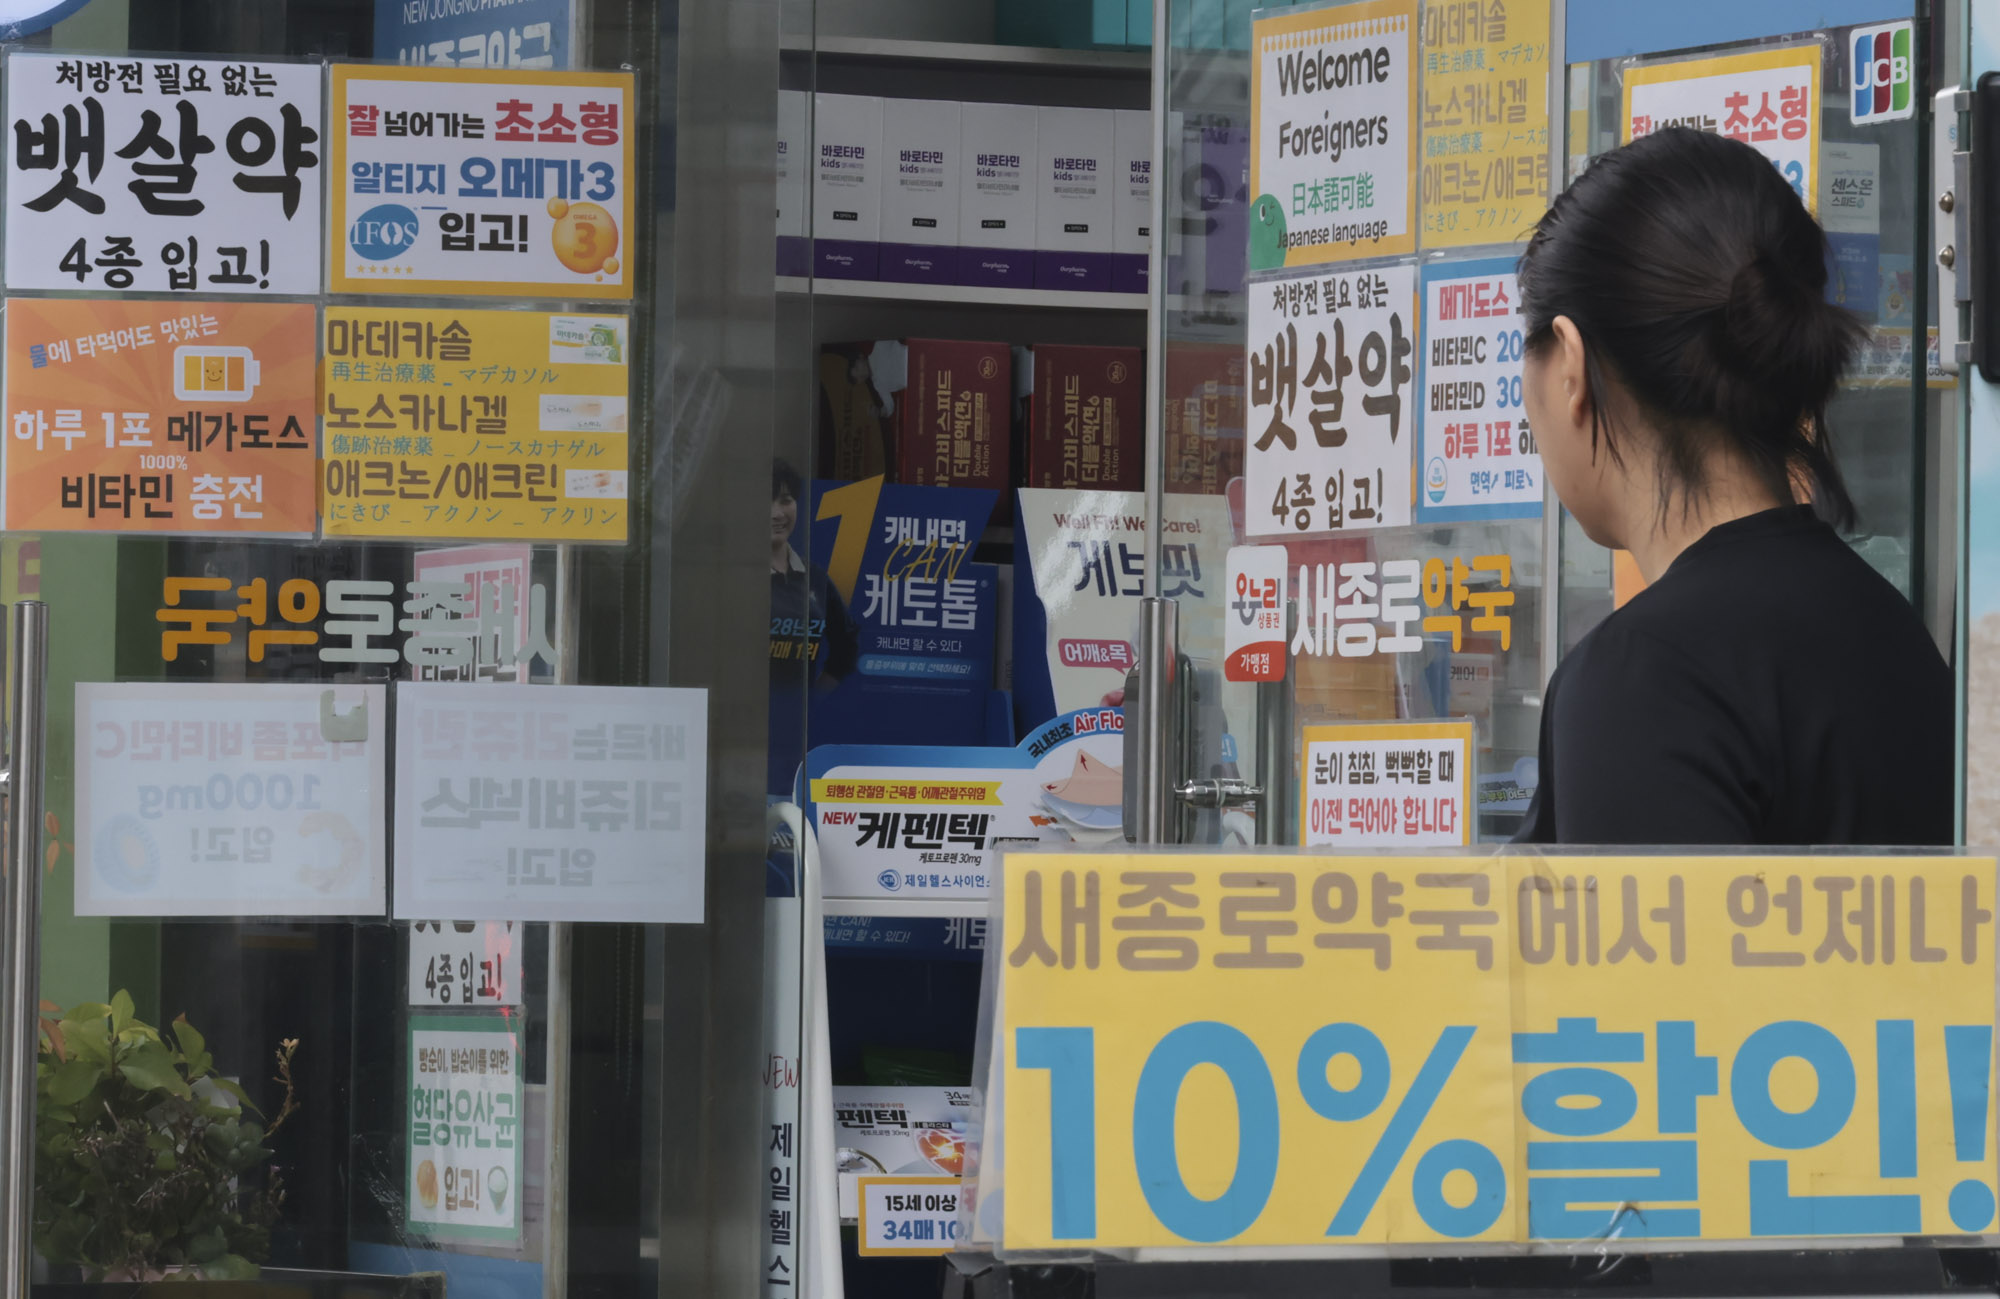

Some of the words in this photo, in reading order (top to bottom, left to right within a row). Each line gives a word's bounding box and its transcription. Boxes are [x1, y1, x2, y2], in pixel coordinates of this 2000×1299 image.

[403, 3, 429, 24] NEW
[1426, 0, 1506, 48] 마데카솔
[56, 60, 143, 94] 처방전
[154, 63, 211, 95] 필요
[222, 65, 277, 97] 없는
[1277, 46, 1390, 97] Welcome
[1854, 57, 1909, 90] JCB
[1424, 78, 1527, 128] 노스카나겔
[1724, 85, 1808, 143] 초소형
[348, 104, 379, 136] 잘
[384, 111, 485, 139] 넘어가는
[495, 99, 619, 146] 초소형
[1279, 110, 1388, 162] Foreigners
[13, 96, 319, 221] 뱃살약
[821, 158, 840, 169] kids
[822, 144, 865, 160] 바로타민
[900, 149, 943, 165] 바로타민
[900, 163, 919, 174] kids
[977, 153, 1020, 169] 바로타민
[1054, 157, 1097, 172] 바로타민
[1130, 160, 1150, 175] 바로
[351, 161, 446, 195] 알티지
[458, 156, 616, 202] 오메가3
[976, 167, 996, 178] kids
[1053, 170, 1073, 182] kids
[1292, 172, 1374, 217] 日本語可能
[351, 221, 418, 247] IFOS
[439, 213, 529, 253] 입고!
[1277, 223, 1330, 251] Japanese
[1332, 219, 1388, 245] language
[1424, 210, 1458, 233] にきび
[59, 236, 143, 288] 4종
[161, 235, 270, 290] 입고!
[1273, 281, 1318, 318] 처방전
[1323, 277, 1351, 314] 필요
[1357, 274, 1388, 309] 없는
[1439, 281, 1509, 320] 메가도스
[29, 340, 71, 368] 물에
[77, 325, 155, 357] 타먹어도
[160, 314, 218, 343] 맛있는
[327, 319, 473, 361] 마데카솔
[1432, 336, 1486, 366] 비타민C
[1497, 329, 1523, 362] 20
[332, 362, 436, 384] 再生治療薬
[459, 365, 559, 385] マデカソル
[1250, 312, 1411, 452] 뱃살약
[1431, 382, 1485, 412] 비타민D
[1496, 376, 1523, 408] 30
[13, 409, 86, 450] 하루
[101, 412, 153, 448] 1포
[167, 411, 309, 452] 메가도스
[326, 393, 508, 434] 노스카나겔
[332, 435, 433, 456] 傷跡治療薬
[467, 439, 605, 459] ノースカナゲル
[1444, 423, 1478, 459] 하루
[1485, 421, 1512, 457] 1포
[139, 454, 188, 470] 1000%
[326, 459, 557, 502] 애크논/애크린
[1505, 469, 1524, 490] 피로
[61, 473, 173, 518] 비타민
[190, 474, 263, 519] 충전
[330, 503, 391, 522] にきび
[423, 504, 502, 524] アクノン
[540, 506, 617, 526] アクリン
[1272, 473, 1315, 530] 4종
[1325, 467, 1383, 530] 입고!
[884, 516, 967, 549] 캐내면
[1123, 515, 1145, 531] We
[884, 538, 972, 582] CAN
[862, 574, 978, 630] 케토톱
[1291, 555, 1515, 657] 새종로약국
[1258, 613, 1280, 630] 상품권
[877, 636, 910, 651] 캐내면
[912, 638, 924, 652] 할
[926, 639, 937, 653] 수
[940, 640, 962, 653] 있다
[1064, 643, 1127, 664] 어깨&목
[1241, 652, 1270, 675] 가맹점
[1027, 722, 1074, 758] 국내최초
[1075, 713, 1097, 733] Air
[1100, 711, 1124, 729] Flo
[1315, 752, 1342, 785] 눈이
[1348, 751, 1380, 785] 침침,
[1385, 749, 1432, 785] 뻑뻑할
[1439, 750, 1454, 782] 때
[826, 784, 855, 798] 퇴행성
[823, 812, 858, 825] NEW
[856, 813, 990, 850] 케펜텍
[1311, 798, 1342, 834] 이젠
[1348, 796, 1397, 834] 먹어야
[1403, 796, 1457, 834] 합니다
[959, 853, 982, 866] 30mg
[943, 917, 987, 950] 케토
[1726, 871, 1993, 968] 언제나
[425, 953, 454, 1004] 4종
[460, 951, 503, 1004] 입고!
[490, 1048, 509, 1075] 위한
[413, 1083, 516, 1149] 혈당유산균
[836, 1109, 908, 1129] 펜텍
[444, 1166, 479, 1211] 입고!
[767, 1123, 792, 1287] 제일헬스
[885, 1195, 921, 1211] 15세
[925, 1195, 957, 1211] 이상
[883, 1220, 934, 1240] 34매
